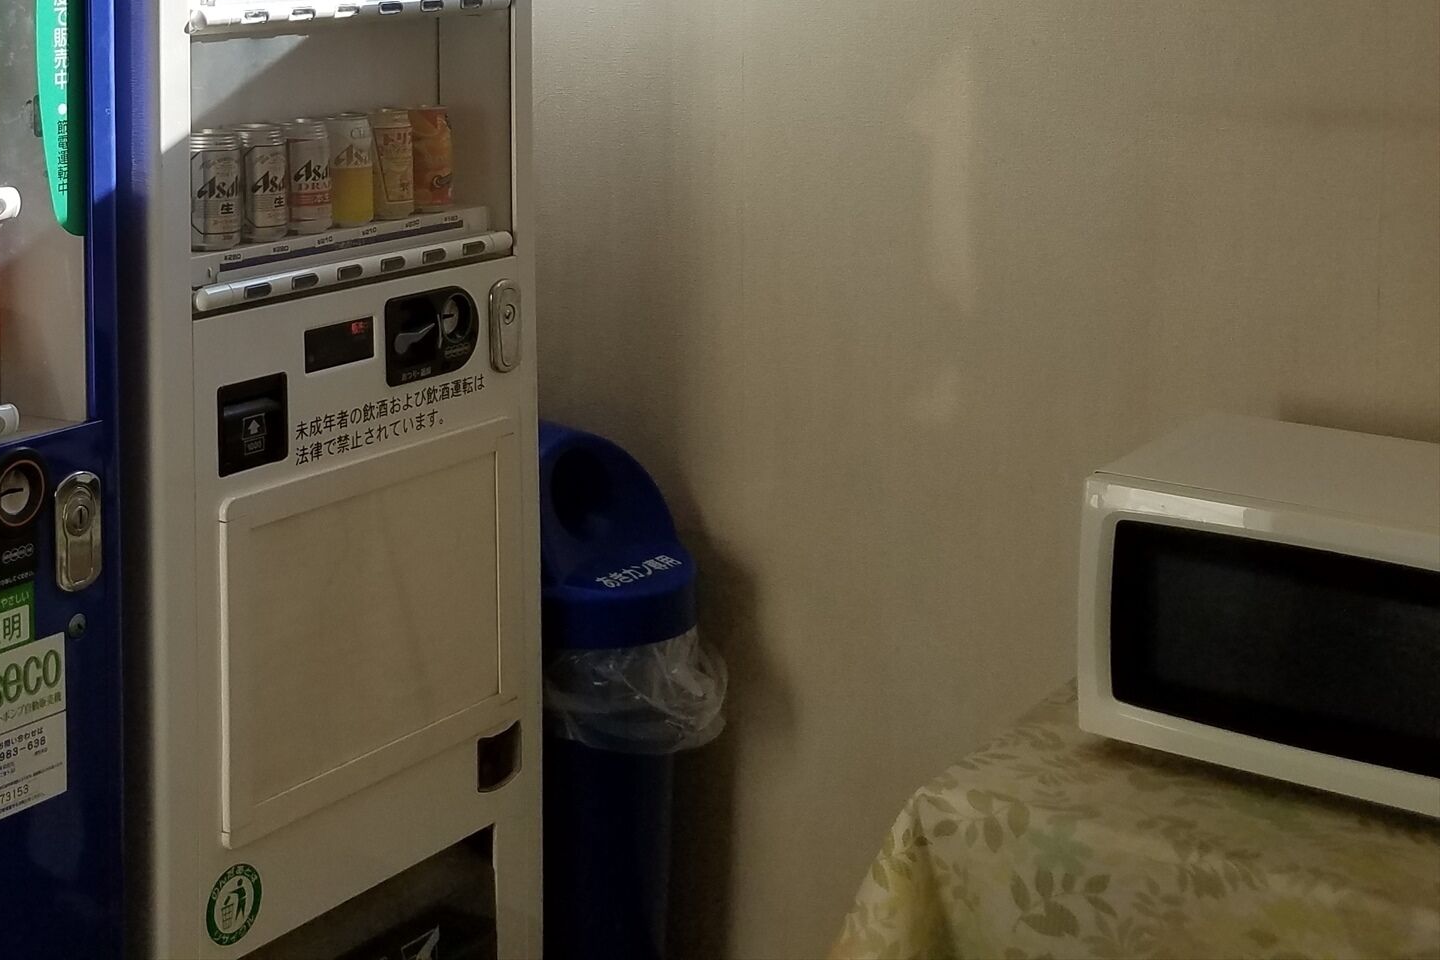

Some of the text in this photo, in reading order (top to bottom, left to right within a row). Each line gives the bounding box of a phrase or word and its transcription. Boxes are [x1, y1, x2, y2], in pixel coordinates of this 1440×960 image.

[220, 202, 235, 215] 生
[273, 195, 286, 209] 生
[295, 373, 487, 442] 未成年者の飲酒および飲酒運転は
[294, 408, 445, 467] 法律で禁止されています。
[594, 553, 683, 589] あきカン専用
